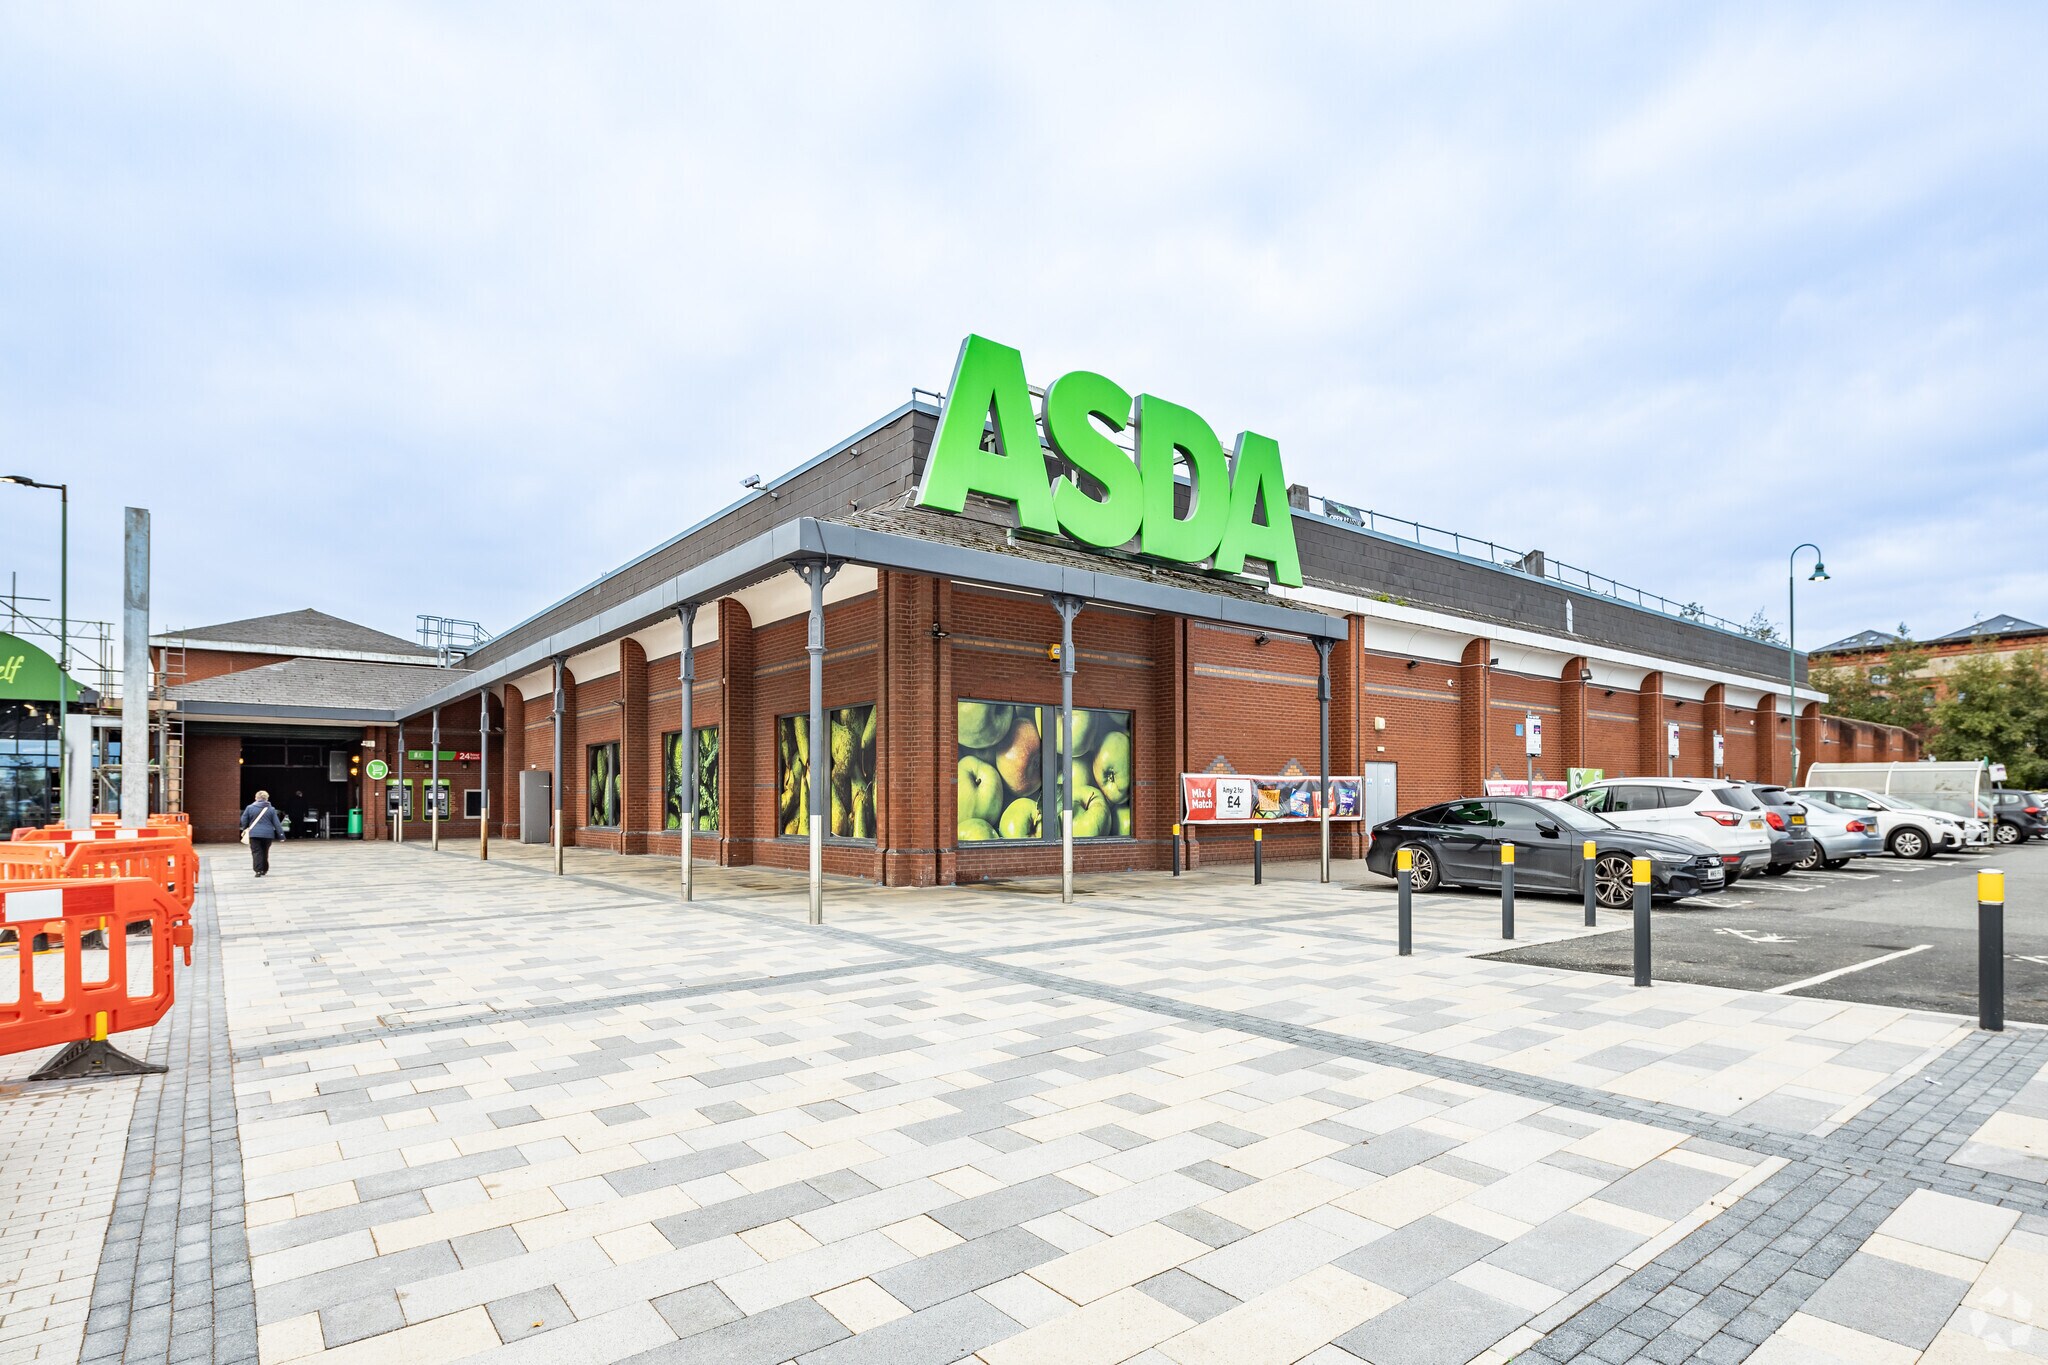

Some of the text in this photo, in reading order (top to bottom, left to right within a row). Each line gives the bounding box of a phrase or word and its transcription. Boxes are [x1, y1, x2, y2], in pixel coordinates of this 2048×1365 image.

[914, 333, 1303, 588] ASDA
[459, 752, 470, 760] 24
[1191, 788, 1212, 799] Mix &
[1191, 799, 1213, 809] Match
[1227, 795, 1241, 808] £4
